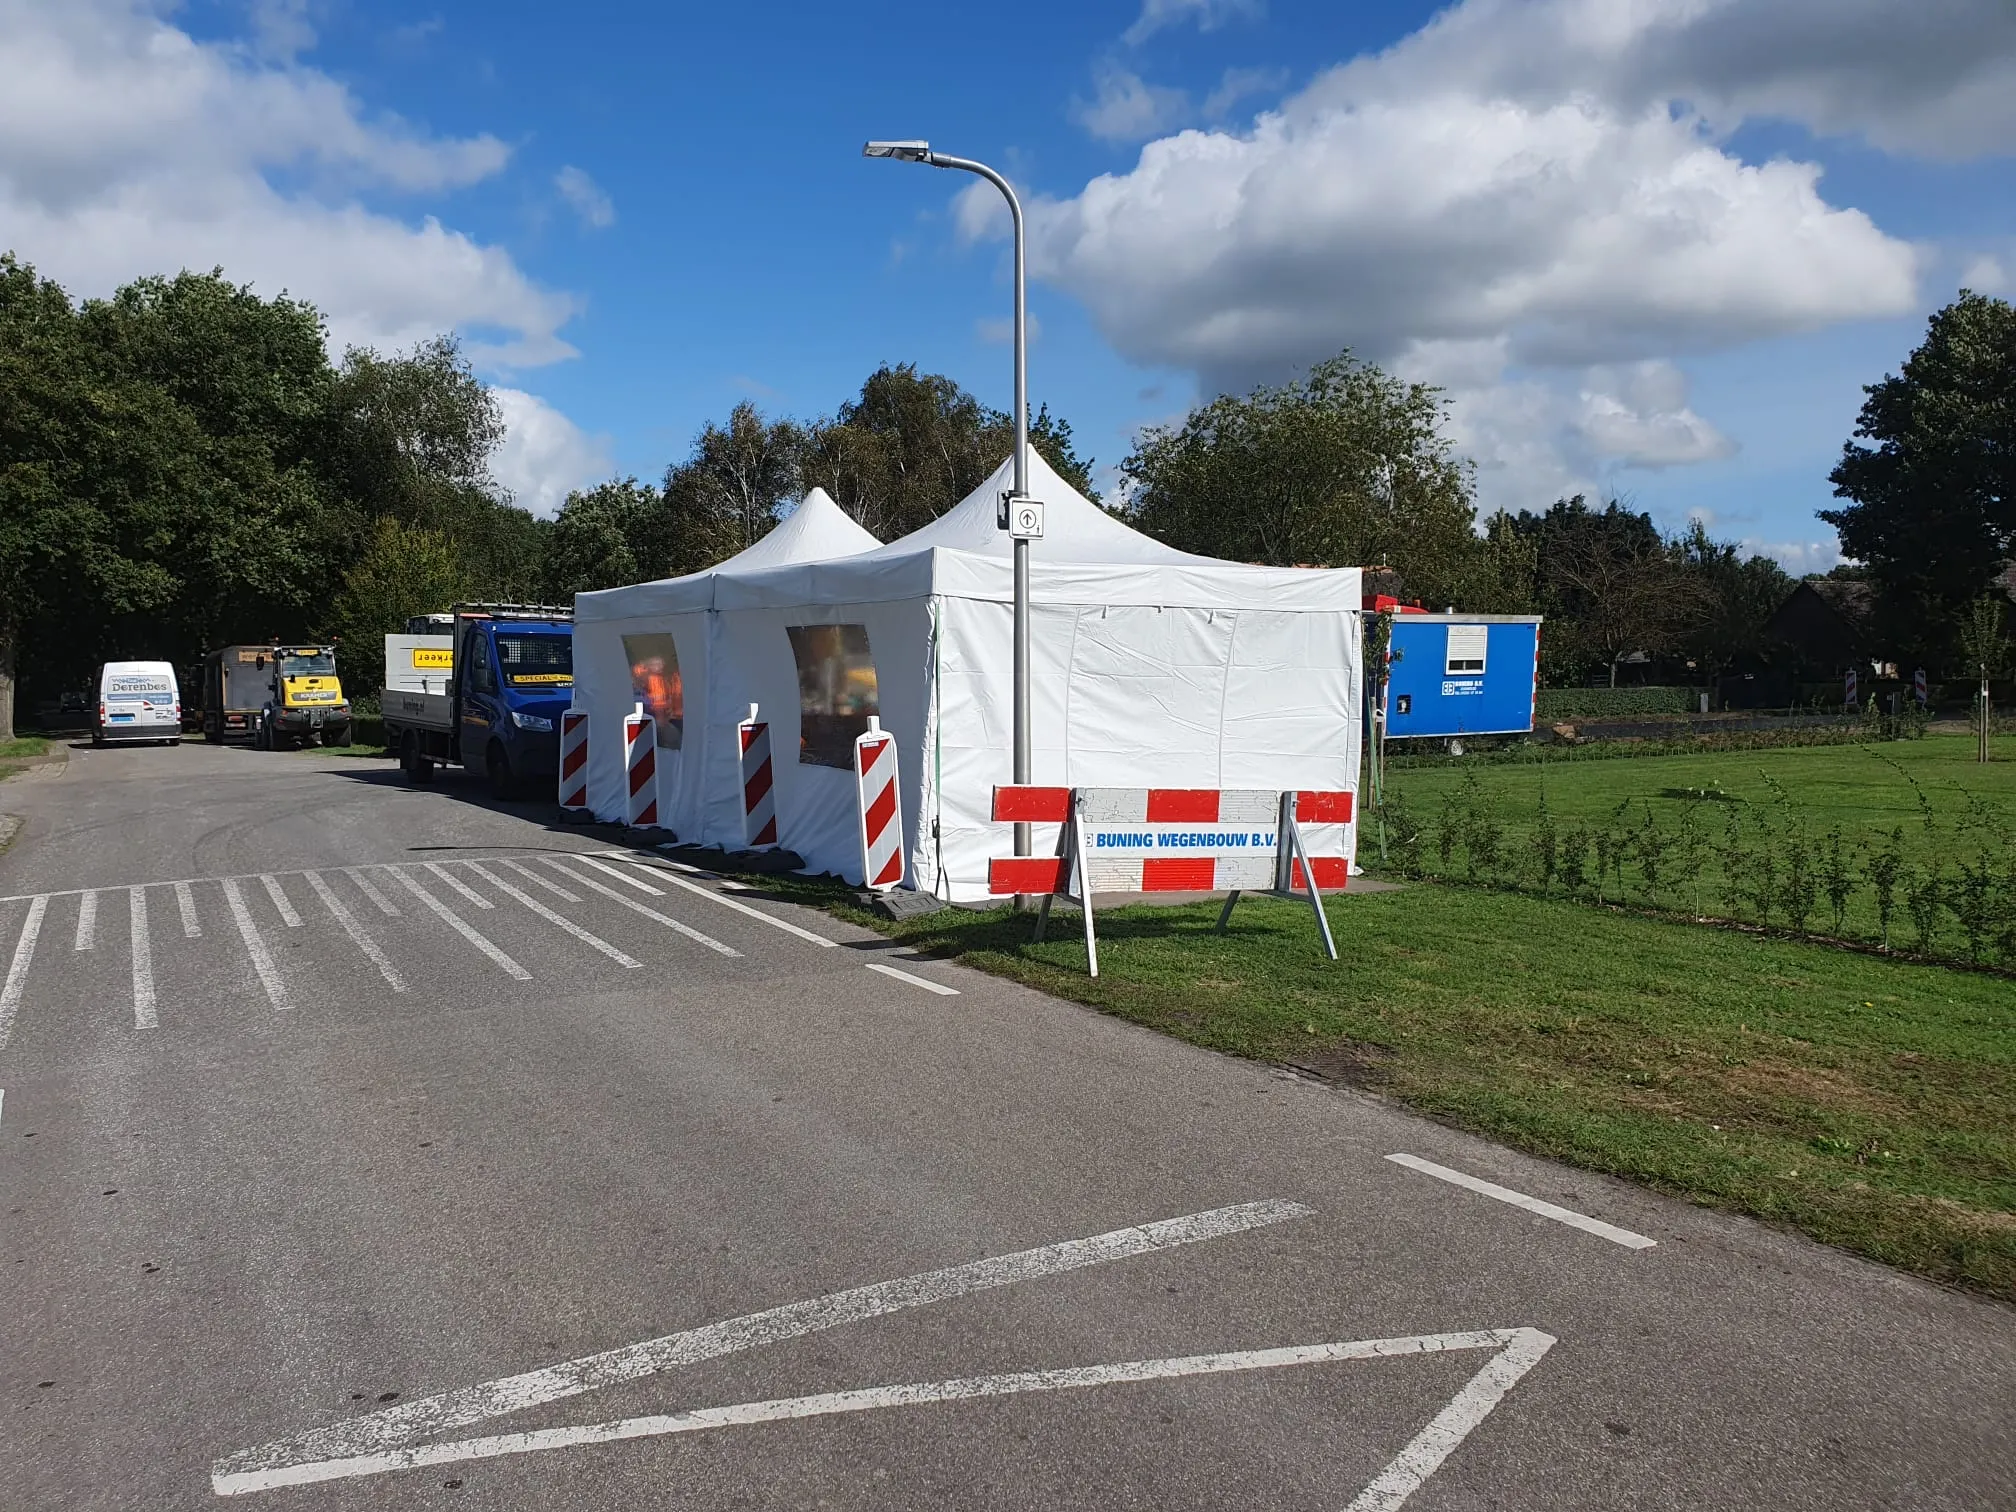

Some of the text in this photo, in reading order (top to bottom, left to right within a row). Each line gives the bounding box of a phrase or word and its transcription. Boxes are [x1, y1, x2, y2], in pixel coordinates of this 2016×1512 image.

[1096, 833, 1153, 847] BUNING
[1157, 833, 1248, 847] WEGENBOUW
[1251, 833, 1277, 847] B.V.
